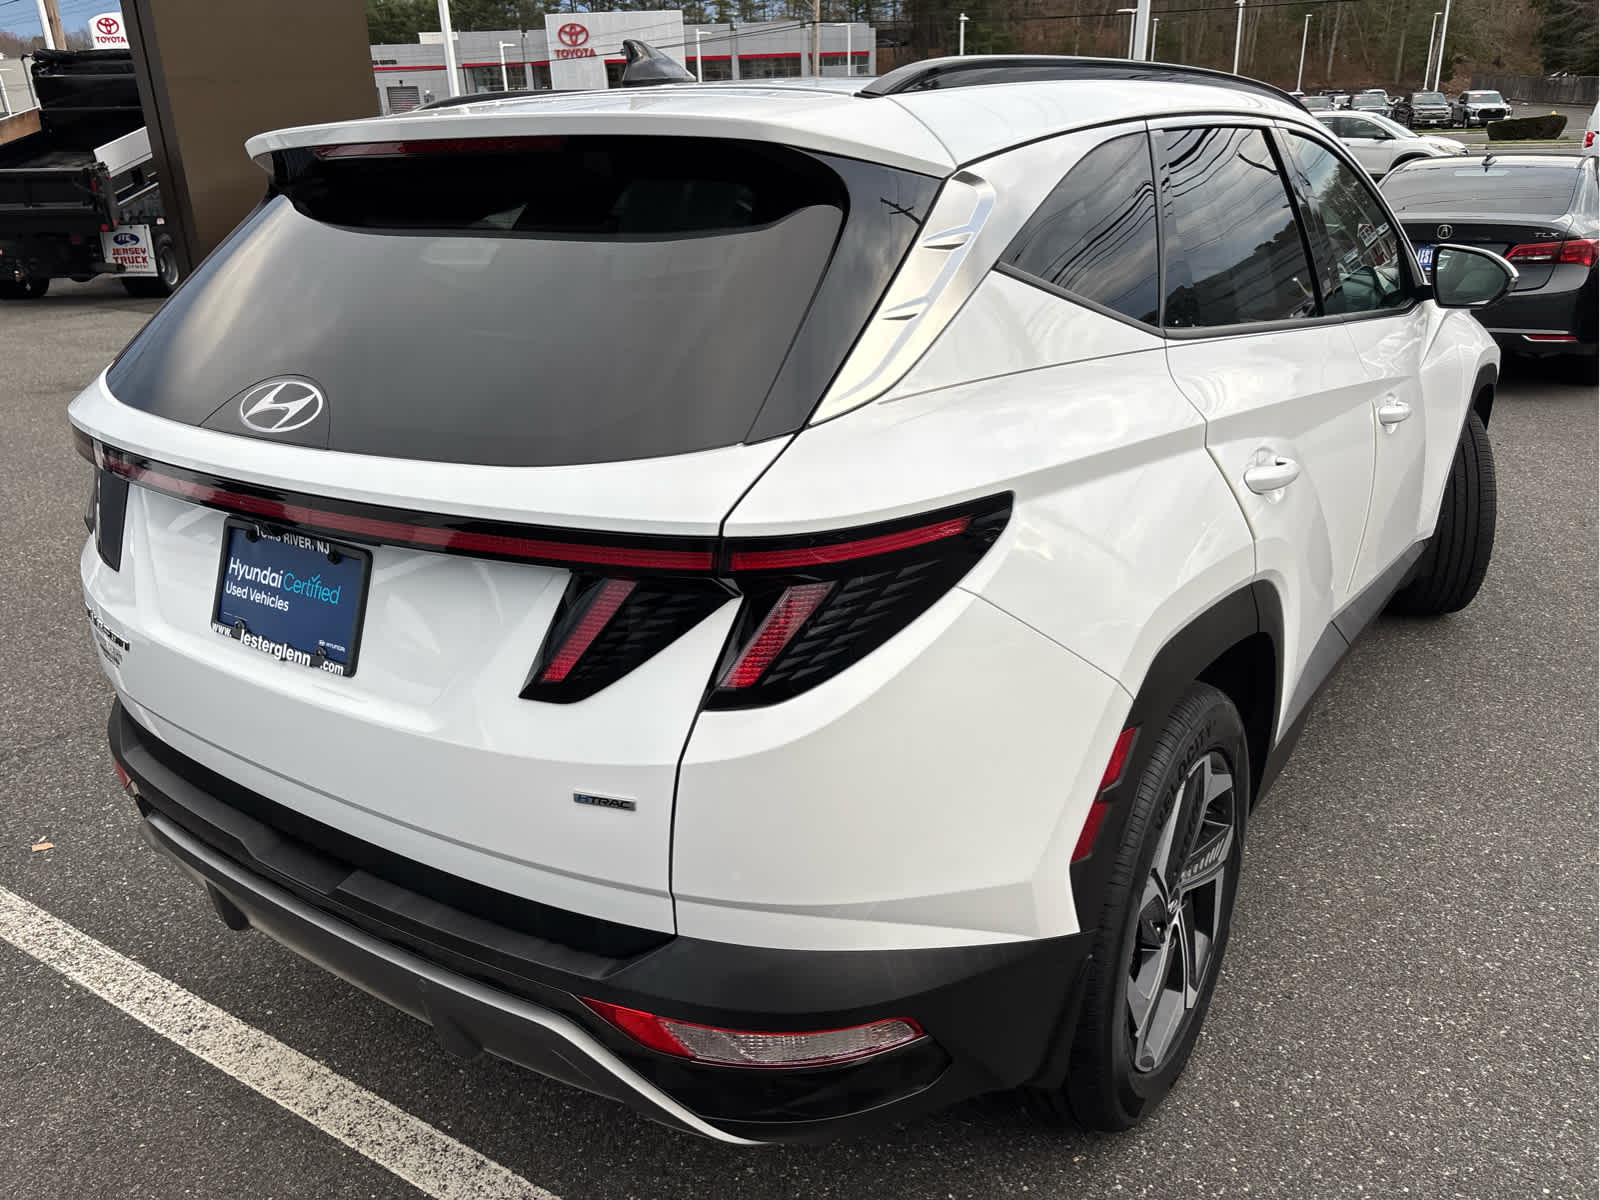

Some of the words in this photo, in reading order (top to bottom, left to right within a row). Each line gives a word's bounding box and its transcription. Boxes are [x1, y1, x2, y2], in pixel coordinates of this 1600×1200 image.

[554, 47, 597, 59] TOYOTA
[112, 247, 146, 255] JERSEY
[112, 256, 149, 264] TRUCK
[283, 532, 315, 551] RIVER,
[316, 540, 330, 554] NJ
[228, 557, 283, 588] Hyundai
[283, 573, 341, 604] Certified
[225, 580, 249, 600] Used
[250, 587, 289, 612] Vehicles
[211, 622, 232, 638] www.
